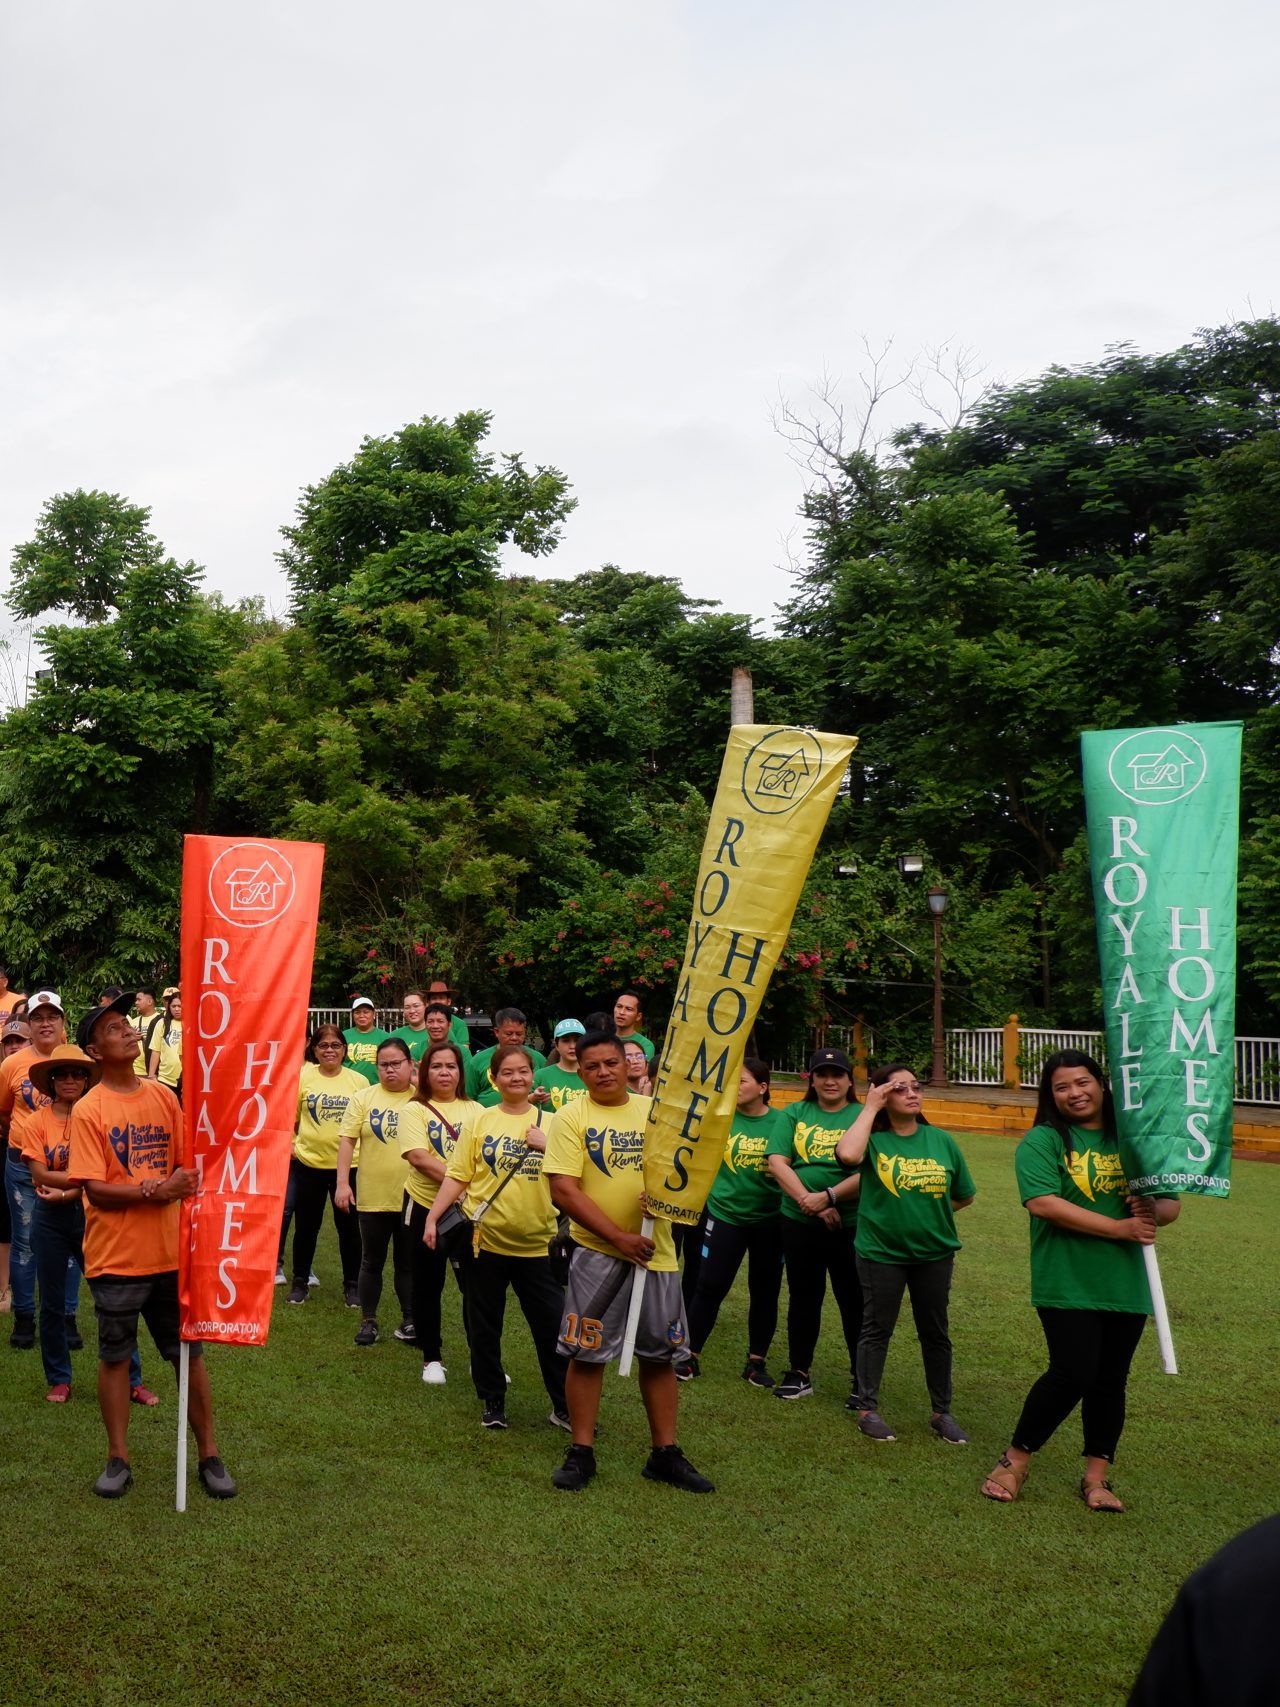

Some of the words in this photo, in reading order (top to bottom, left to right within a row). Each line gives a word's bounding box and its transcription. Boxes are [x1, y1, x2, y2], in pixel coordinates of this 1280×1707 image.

[1103, 816, 1151, 1111] ROYALE
[1167, 906, 1222, 1163] HOMES
[664, 930, 768, 1192] HOMES
[216, 1040, 282, 1310] HOMES
[608, 1152, 642, 1170] Kamp
[646, 1195, 701, 1220] CORPORATIO
[1161, 1173, 1231, 1190] CORPORATIO
[563, 1312, 604, 1351] 16
